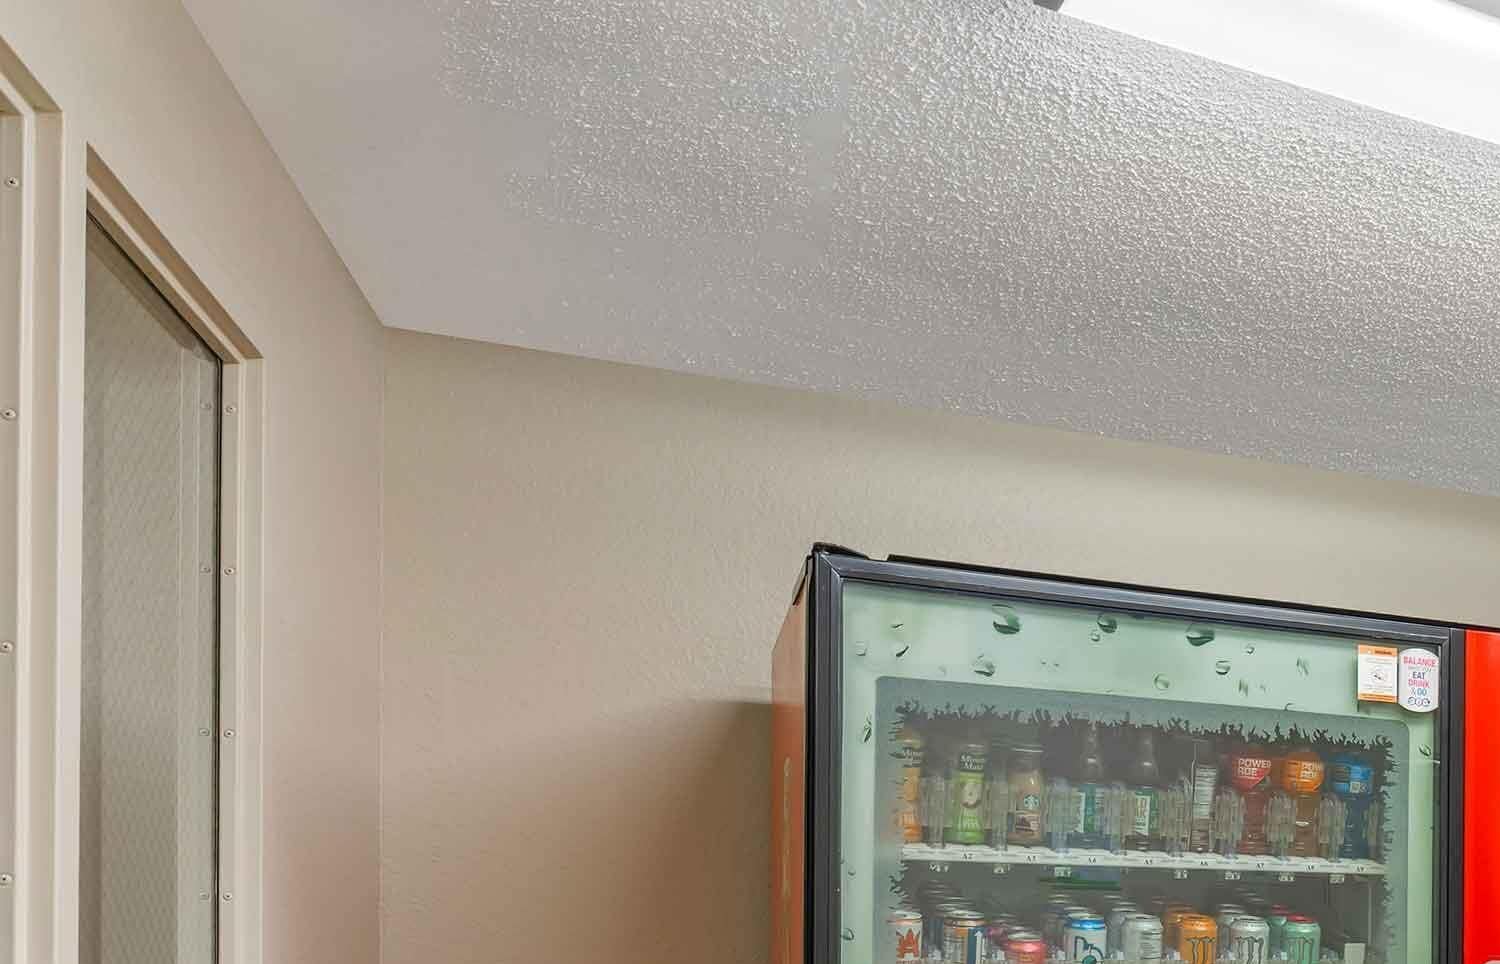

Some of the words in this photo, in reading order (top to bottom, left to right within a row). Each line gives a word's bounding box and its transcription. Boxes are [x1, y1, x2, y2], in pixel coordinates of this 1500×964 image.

[1404, 656, 1437, 667] BALANCE
[1412, 671, 1425, 680] EAT
[1408, 679, 1430, 689] DRINK
